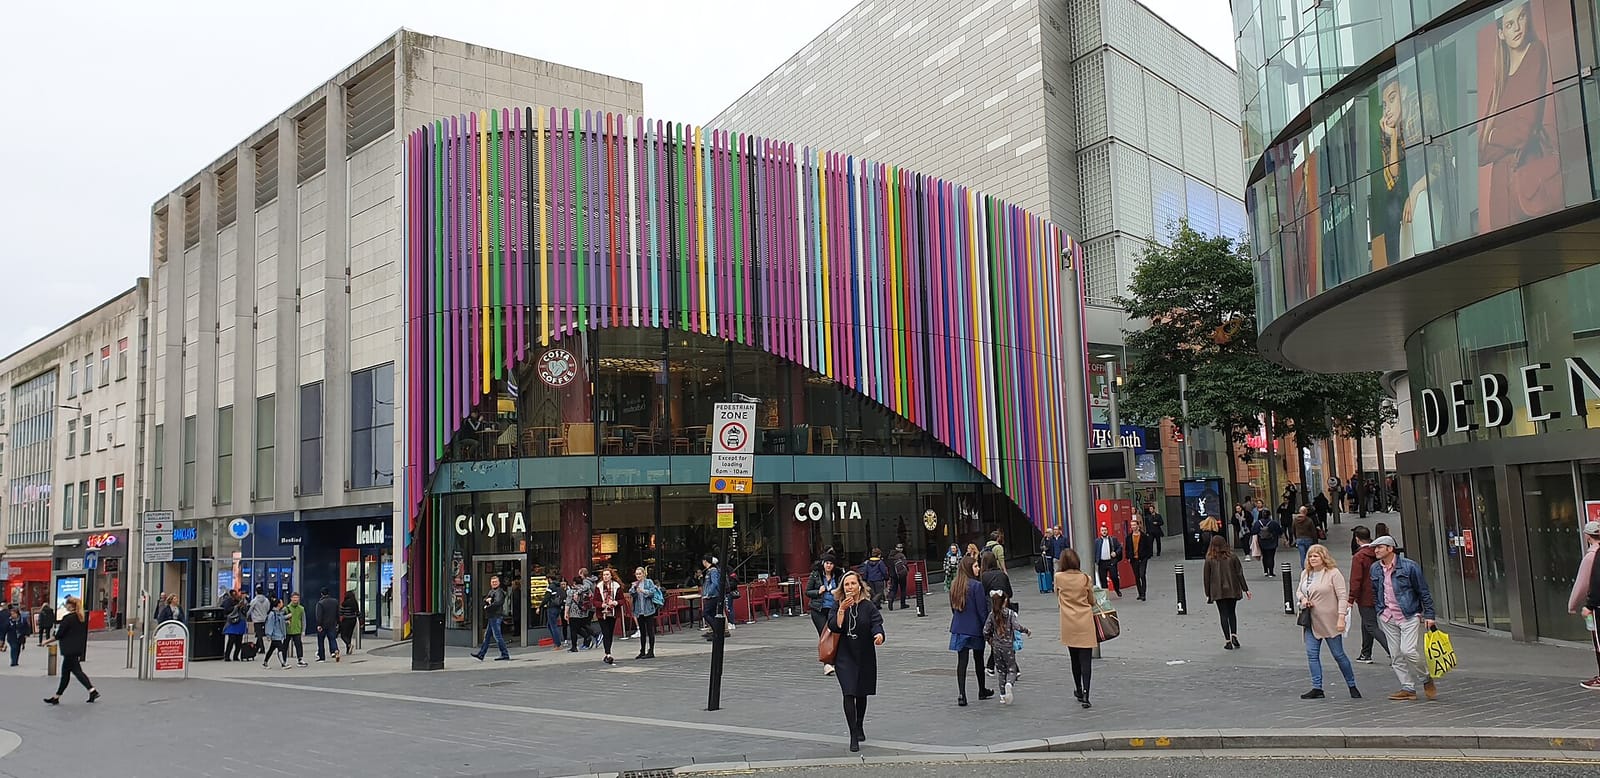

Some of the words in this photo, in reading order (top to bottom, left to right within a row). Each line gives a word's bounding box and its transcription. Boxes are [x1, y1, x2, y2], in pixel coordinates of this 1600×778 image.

[543, 351, 570, 362] COSTA
[542, 370, 574, 384] COFFEE
[721, 411, 748, 420] ZONE
[794, 501, 862, 521] COTA
[1428, 640, 1447, 660] ISL
